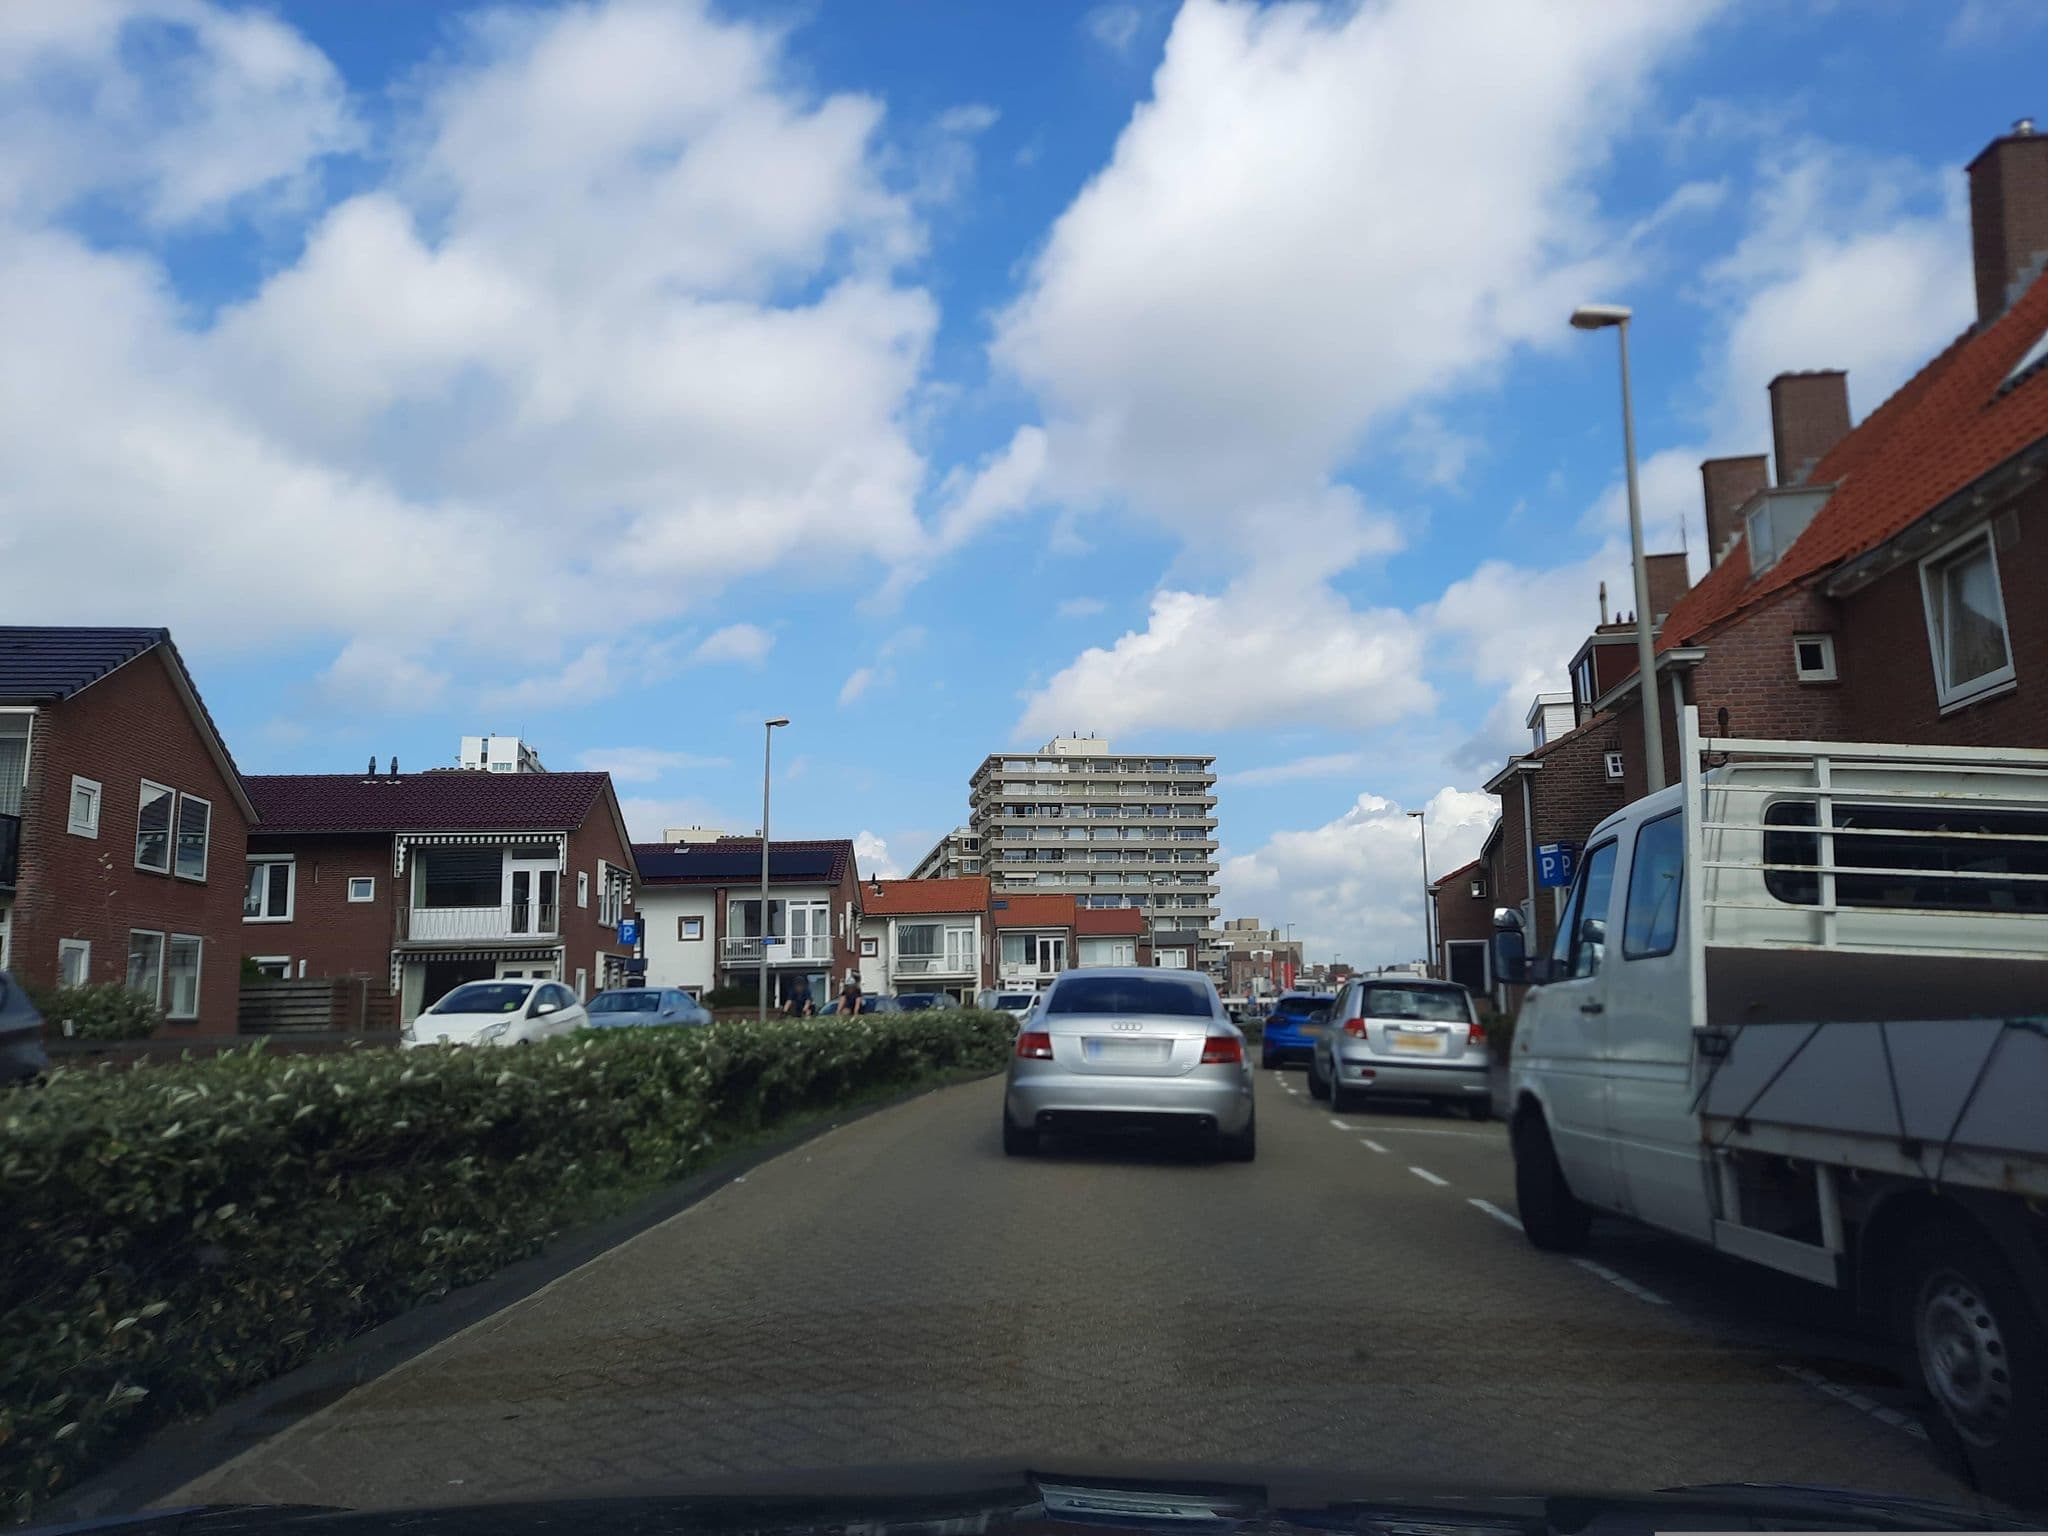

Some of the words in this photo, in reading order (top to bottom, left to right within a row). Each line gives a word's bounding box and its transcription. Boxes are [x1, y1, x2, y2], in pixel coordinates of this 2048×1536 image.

[1542, 857, 1555, 879] P
[1562, 855, 1571, 877] P
[623, 926, 633, 941] P
